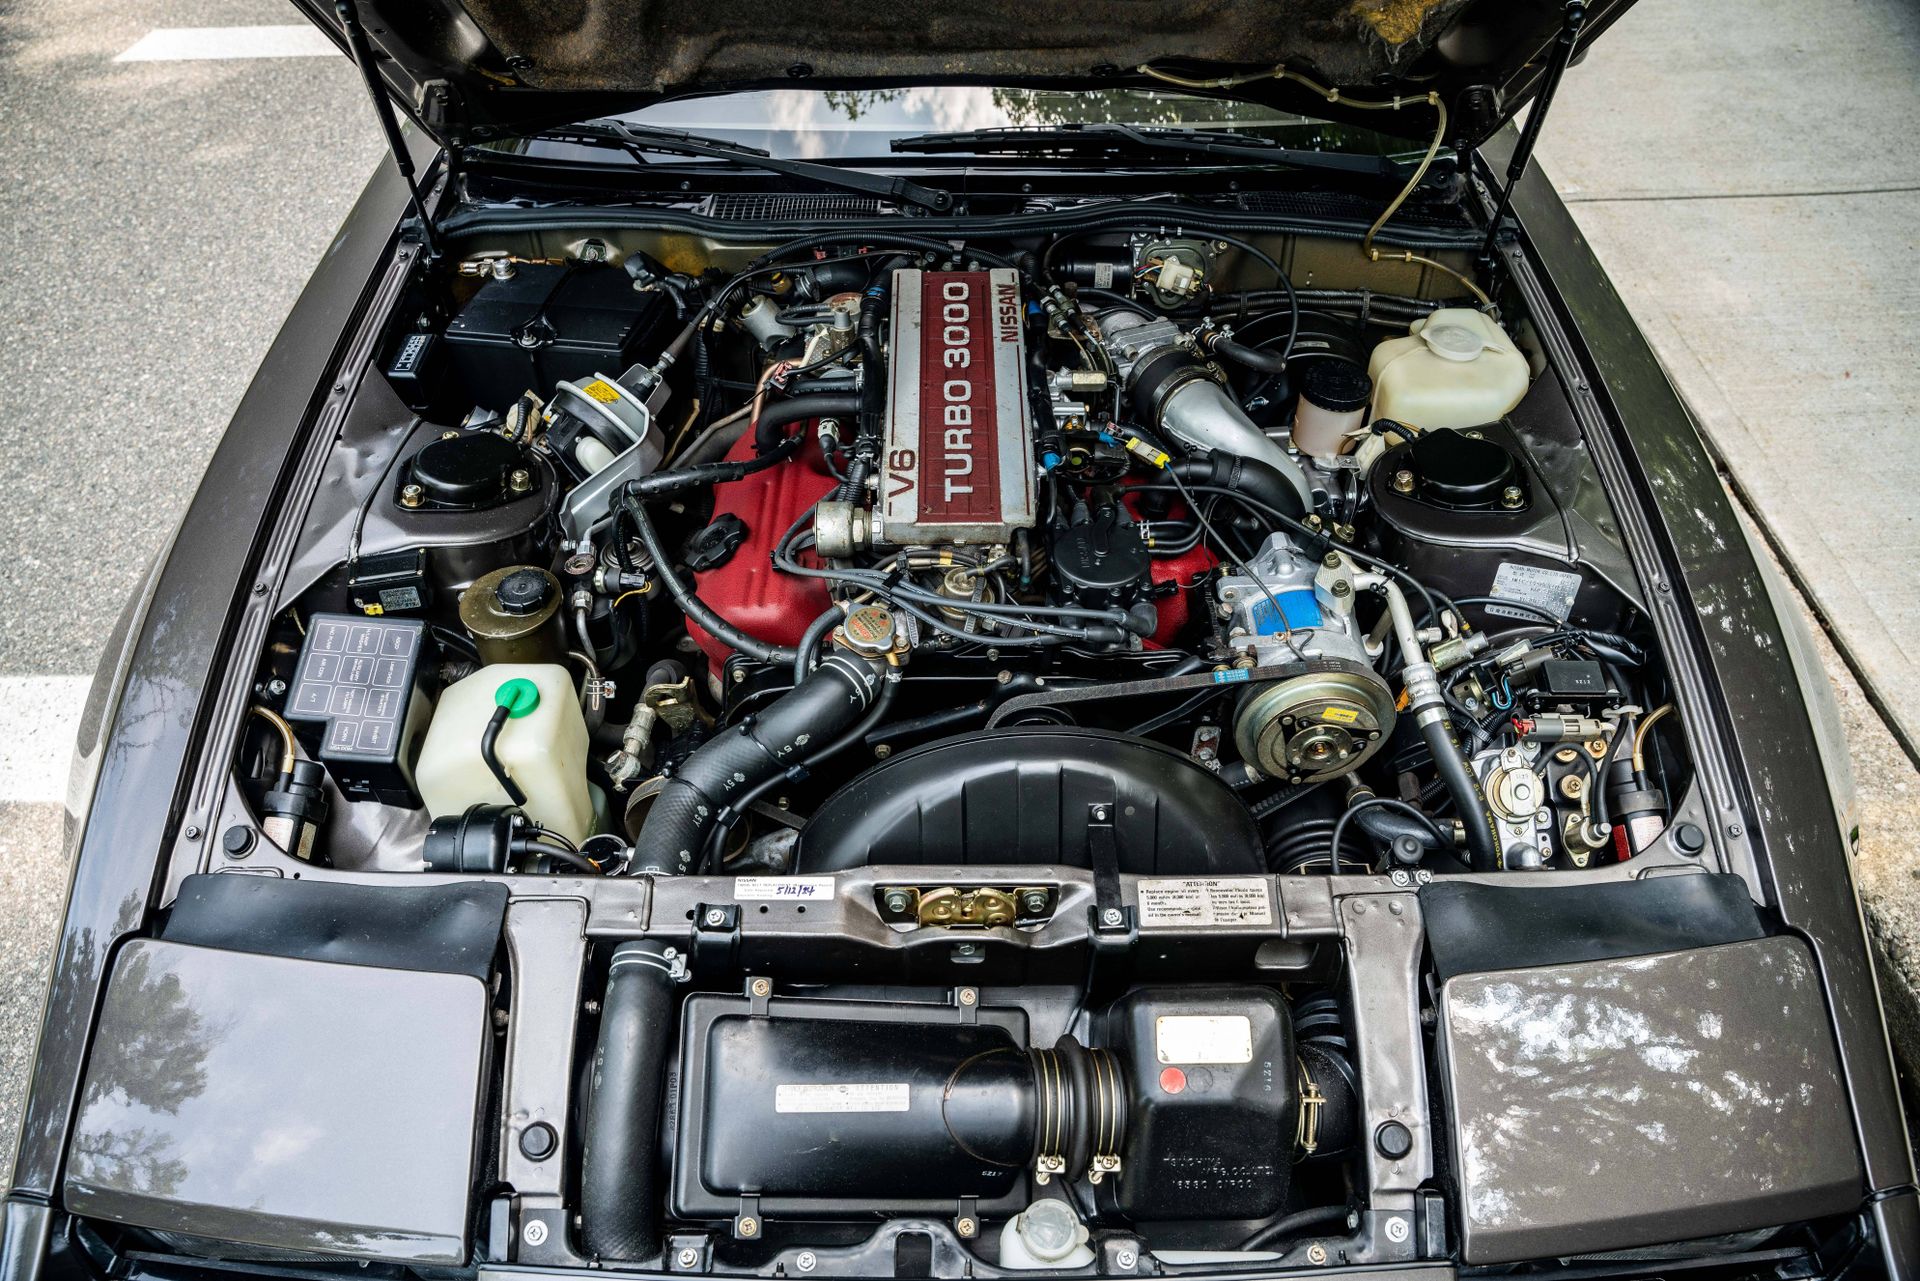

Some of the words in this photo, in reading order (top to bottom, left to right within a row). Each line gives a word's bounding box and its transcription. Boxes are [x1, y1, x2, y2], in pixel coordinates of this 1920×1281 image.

[943, 282, 970, 368] 3000
[998, 284, 1018, 343] NISSAN
[944, 380, 973, 502] TURBO
[888, 449, 916, 498] V6
[776, 745, 792, 758] 5Y
[1462, 761, 1475, 778] LOW
[723, 778, 736, 791] 5Y
[692, 813, 703, 828] 5Y
[1485, 810, 1502, 859] YOKOHAMA
